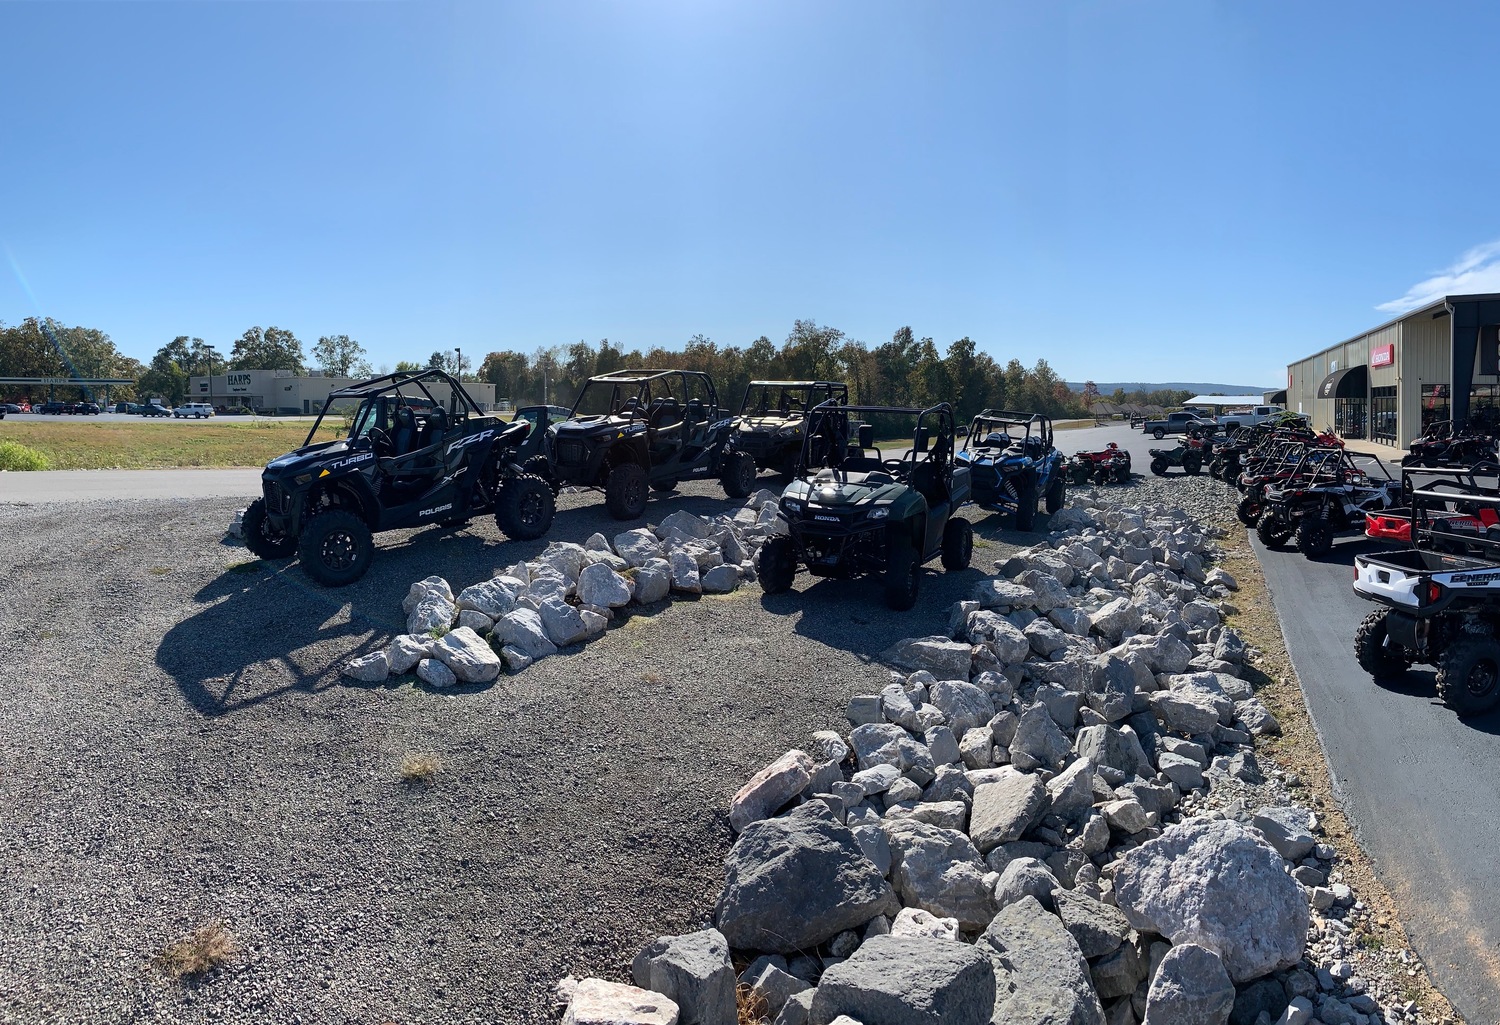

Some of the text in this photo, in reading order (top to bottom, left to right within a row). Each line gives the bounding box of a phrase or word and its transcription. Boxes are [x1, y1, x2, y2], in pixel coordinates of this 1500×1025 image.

[228, 374, 251, 385] HARPS
[624, 422, 646, 433] TURBO
[446, 429, 495, 456] RZR
[331, 452, 374, 469] TURBO
[441, 466, 469, 484] XP
[419, 503, 452, 517] POLARIS
